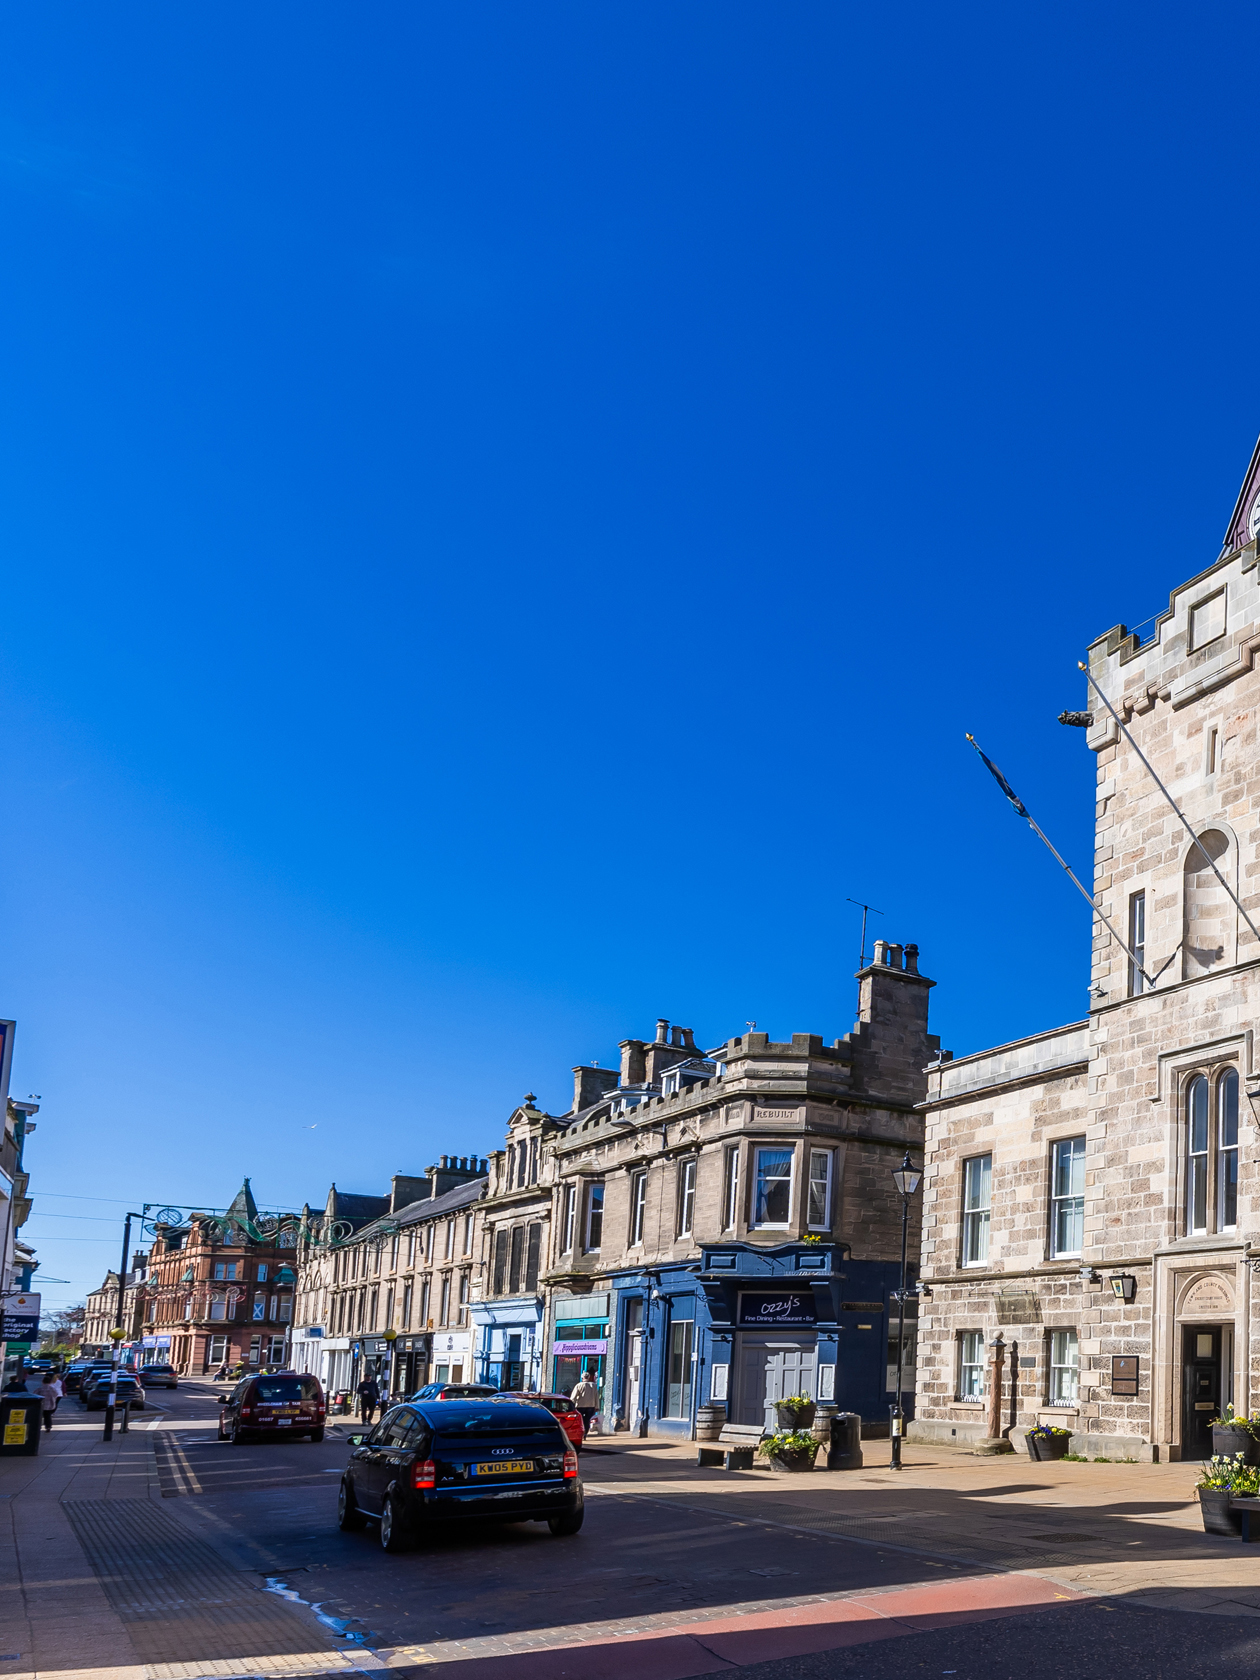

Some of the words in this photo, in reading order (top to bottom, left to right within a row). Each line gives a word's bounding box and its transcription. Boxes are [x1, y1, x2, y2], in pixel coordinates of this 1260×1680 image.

[756, 1110, 795, 1119] REBUILT
[479, 1463, 509, 1474] KW05
[511, 1461, 532, 1472] PYD
